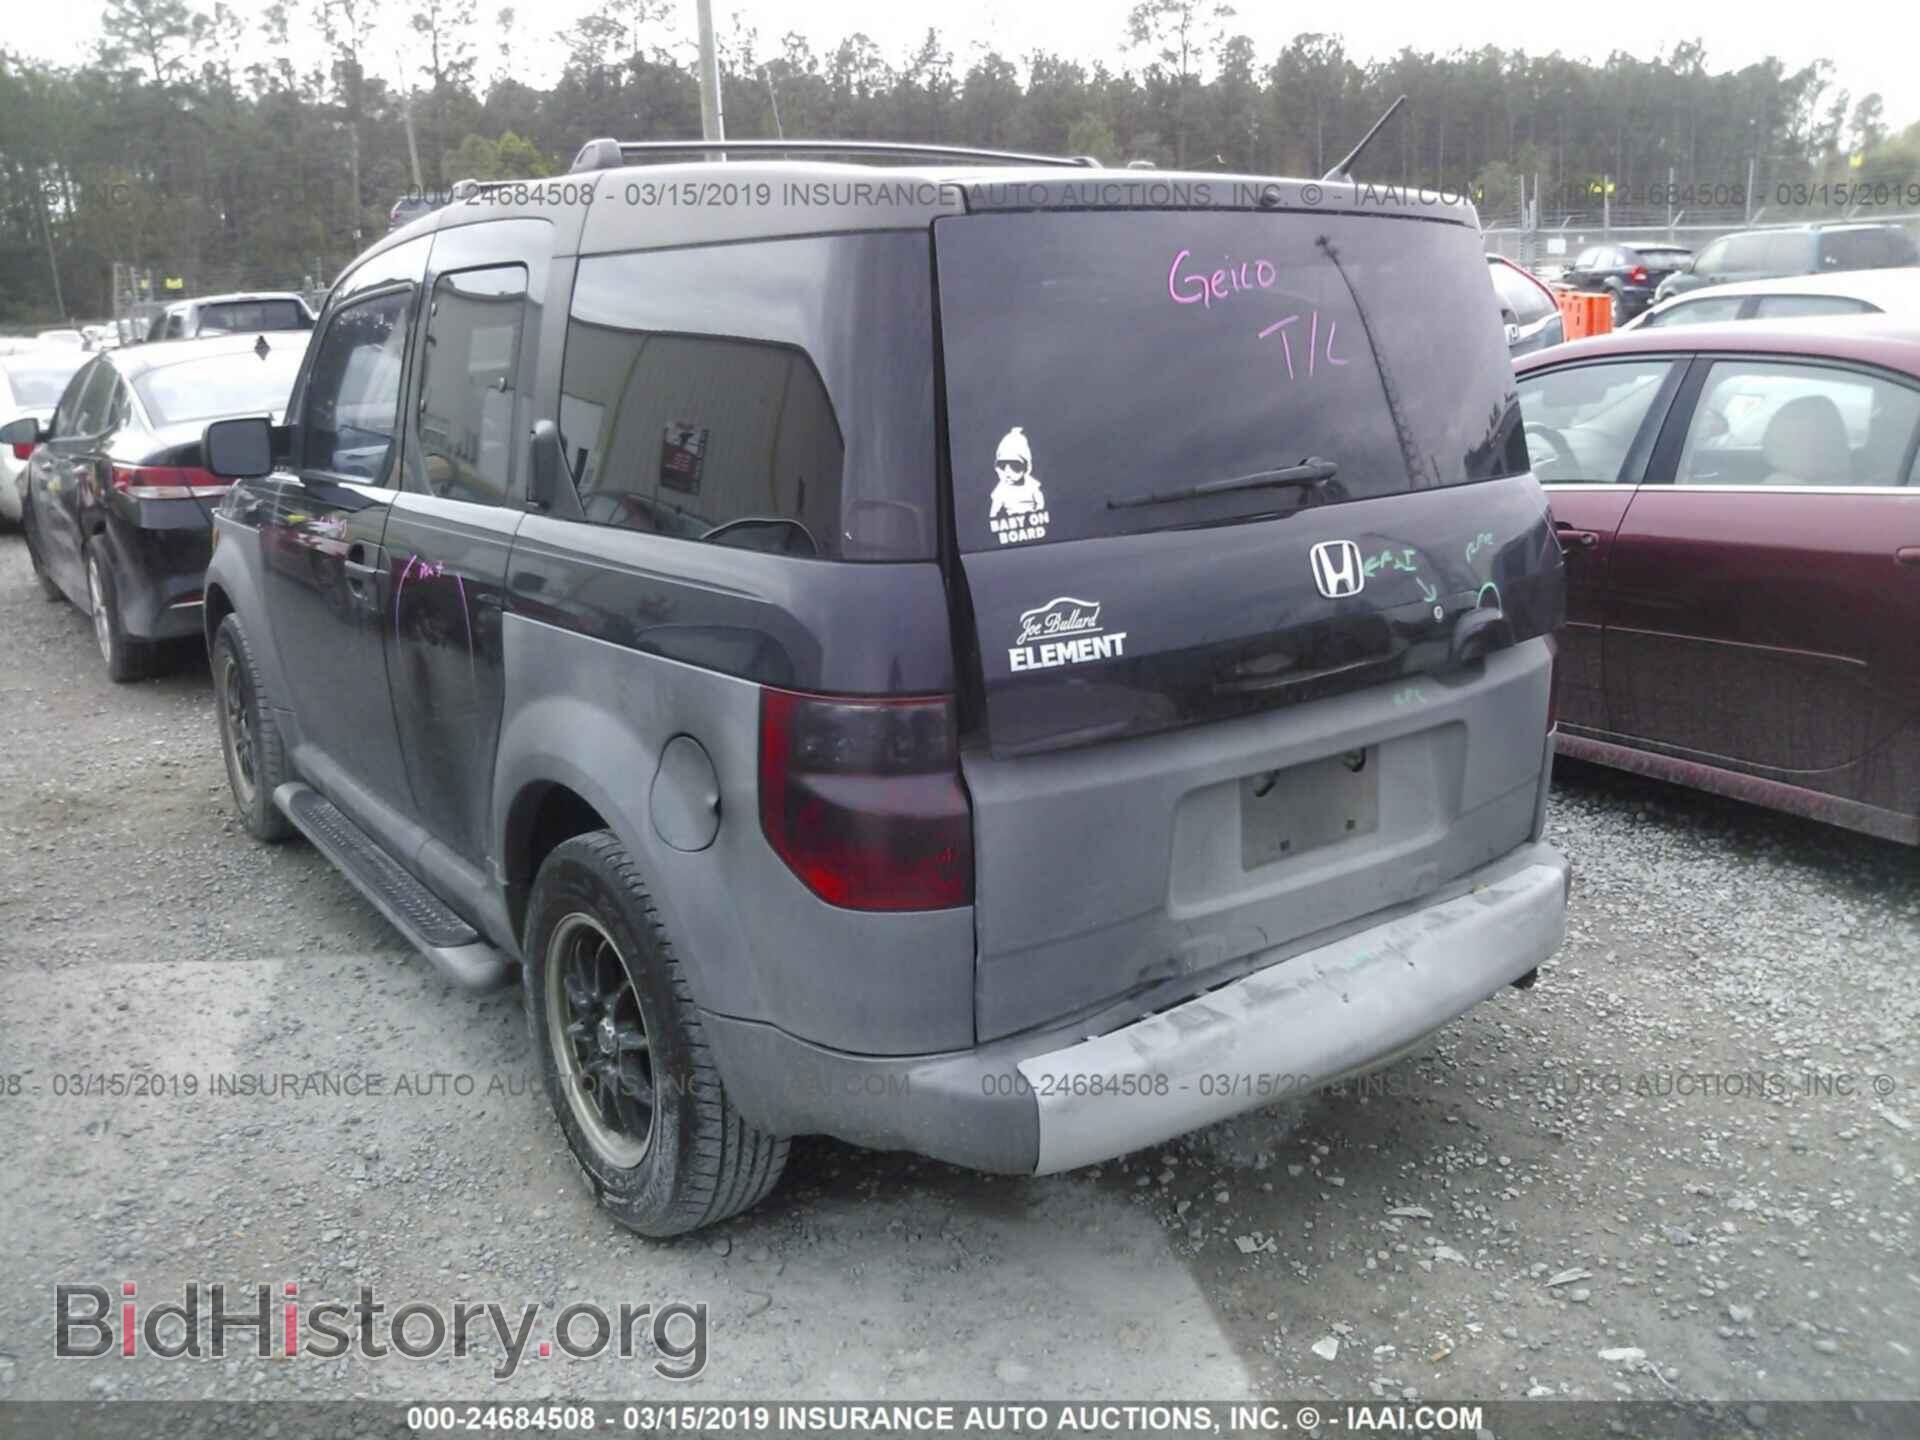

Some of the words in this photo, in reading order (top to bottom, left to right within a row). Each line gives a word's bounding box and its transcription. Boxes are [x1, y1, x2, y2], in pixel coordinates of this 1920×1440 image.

[989, 515, 1026, 533] BABY
[1028, 511, 1050, 527] ON
[998, 527, 1047, 545] BOARD
[1016, 615, 1043, 646] Joe
[1043, 605, 1102, 634] Bullard
[1007, 631, 1128, 673] ELEMENT
